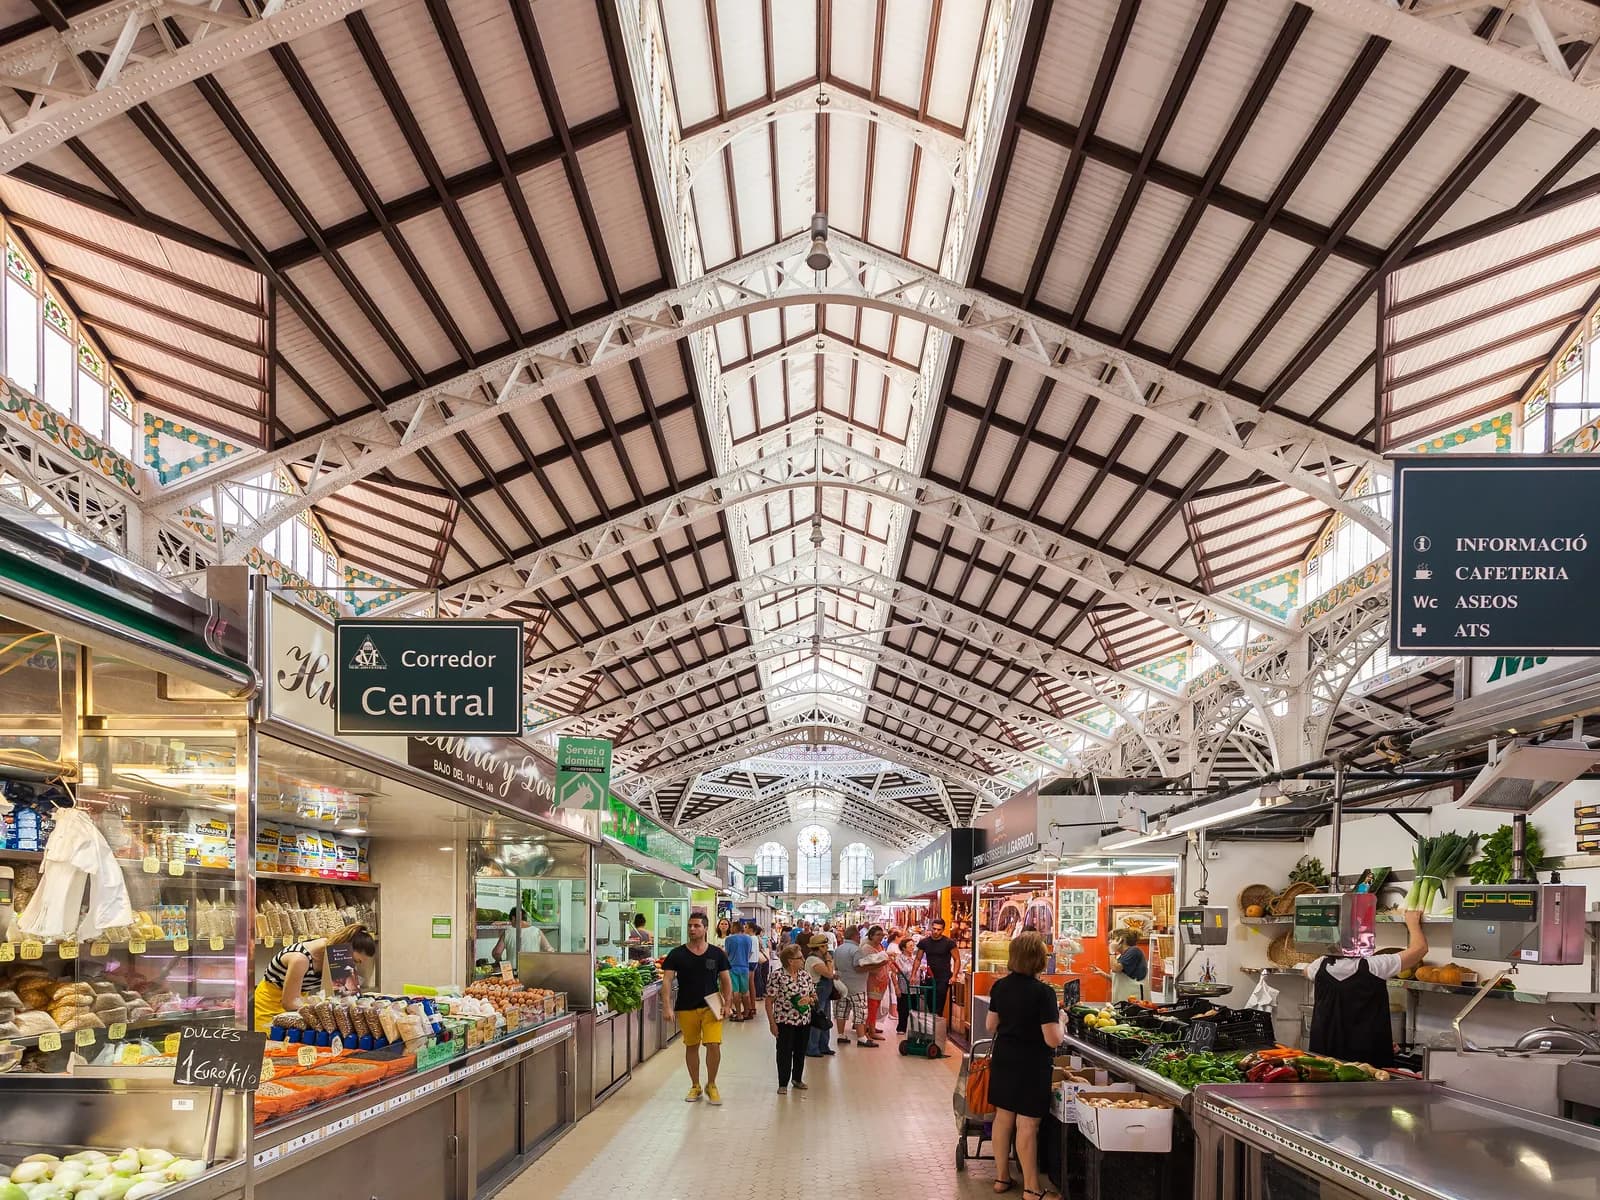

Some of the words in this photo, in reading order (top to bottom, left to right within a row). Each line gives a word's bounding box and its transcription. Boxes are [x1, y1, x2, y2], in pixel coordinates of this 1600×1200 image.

[1455, 533, 1588, 552] INFORMACIÓ
[1455, 566, 1569, 581] CAFETERIA
[1413, 595, 1439, 609] Wc
[1454, 595, 1519, 610] ASEOS
[1453, 623, 1491, 638] ATS
[401, 649, 497, 668] Corredor
[361, 685, 494, 717] Central
[565, 743, 596, 756] Servei
[598, 748, 605, 756] a
[564, 755, 604, 767] domicili
[433, 759, 451, 776] BAJO
[452, 769, 465, 782] DEL
[476, 778, 485, 790] AL
[176, 1049, 195, 1084] 1
